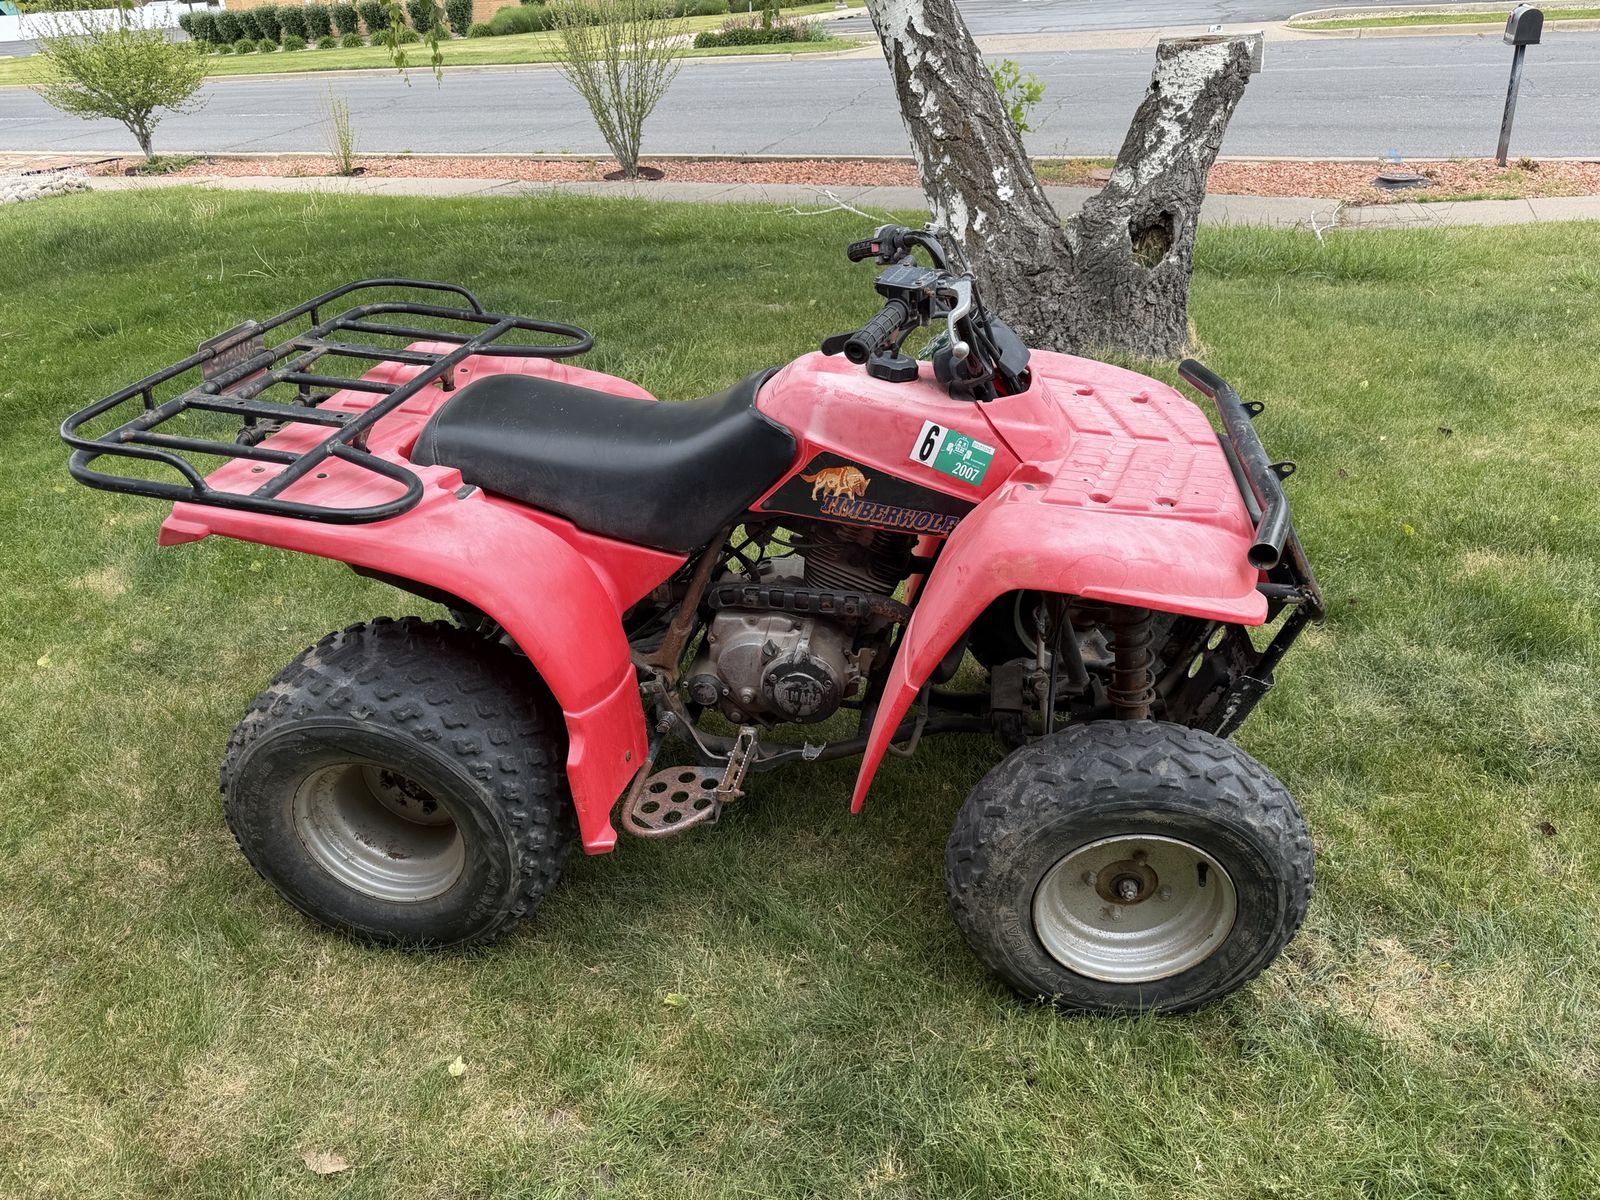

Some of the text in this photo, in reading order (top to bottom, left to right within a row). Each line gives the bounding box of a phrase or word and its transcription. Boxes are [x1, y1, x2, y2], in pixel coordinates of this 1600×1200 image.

[919, 425, 941, 461] 6
[952, 462, 980, 482] 2007
[820, 495, 960, 534] TIMBERWOLF
[777, 687, 822, 705] YAMAHA
